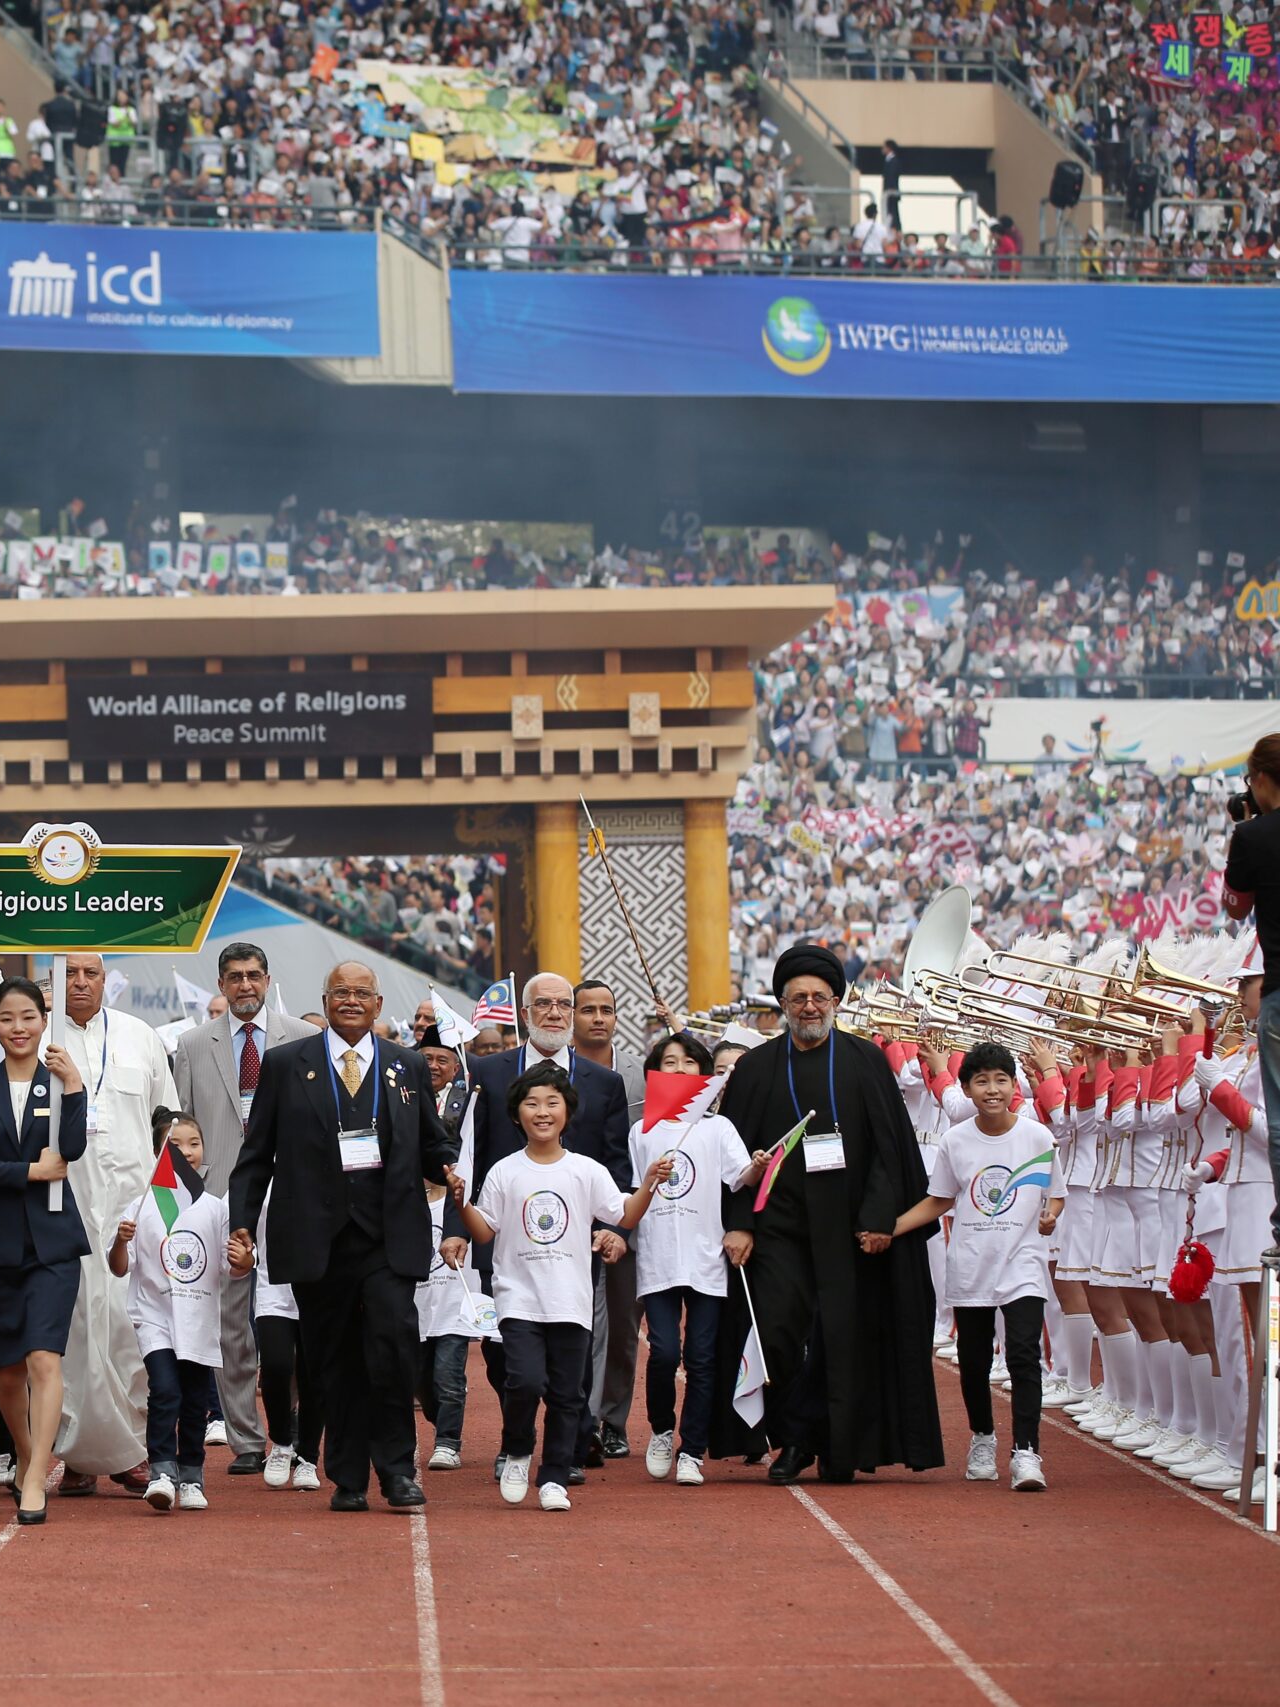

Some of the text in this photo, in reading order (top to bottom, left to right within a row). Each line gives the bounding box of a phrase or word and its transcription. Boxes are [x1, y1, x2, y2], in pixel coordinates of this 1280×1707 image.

[86, 250, 161, 307] icd
[86, 312, 293, 331] institute for cultural diplomacy
[920, 325, 1067, 340] INTERNATIONAL
[837, 323, 911, 351] IWPG
[1024, 341, 1069, 354] GROUP
[88, 691, 407, 716] World Alliance of Religions
[174, 722, 327, 744] Peace Summit
[74, 889, 165, 913] Leaders
